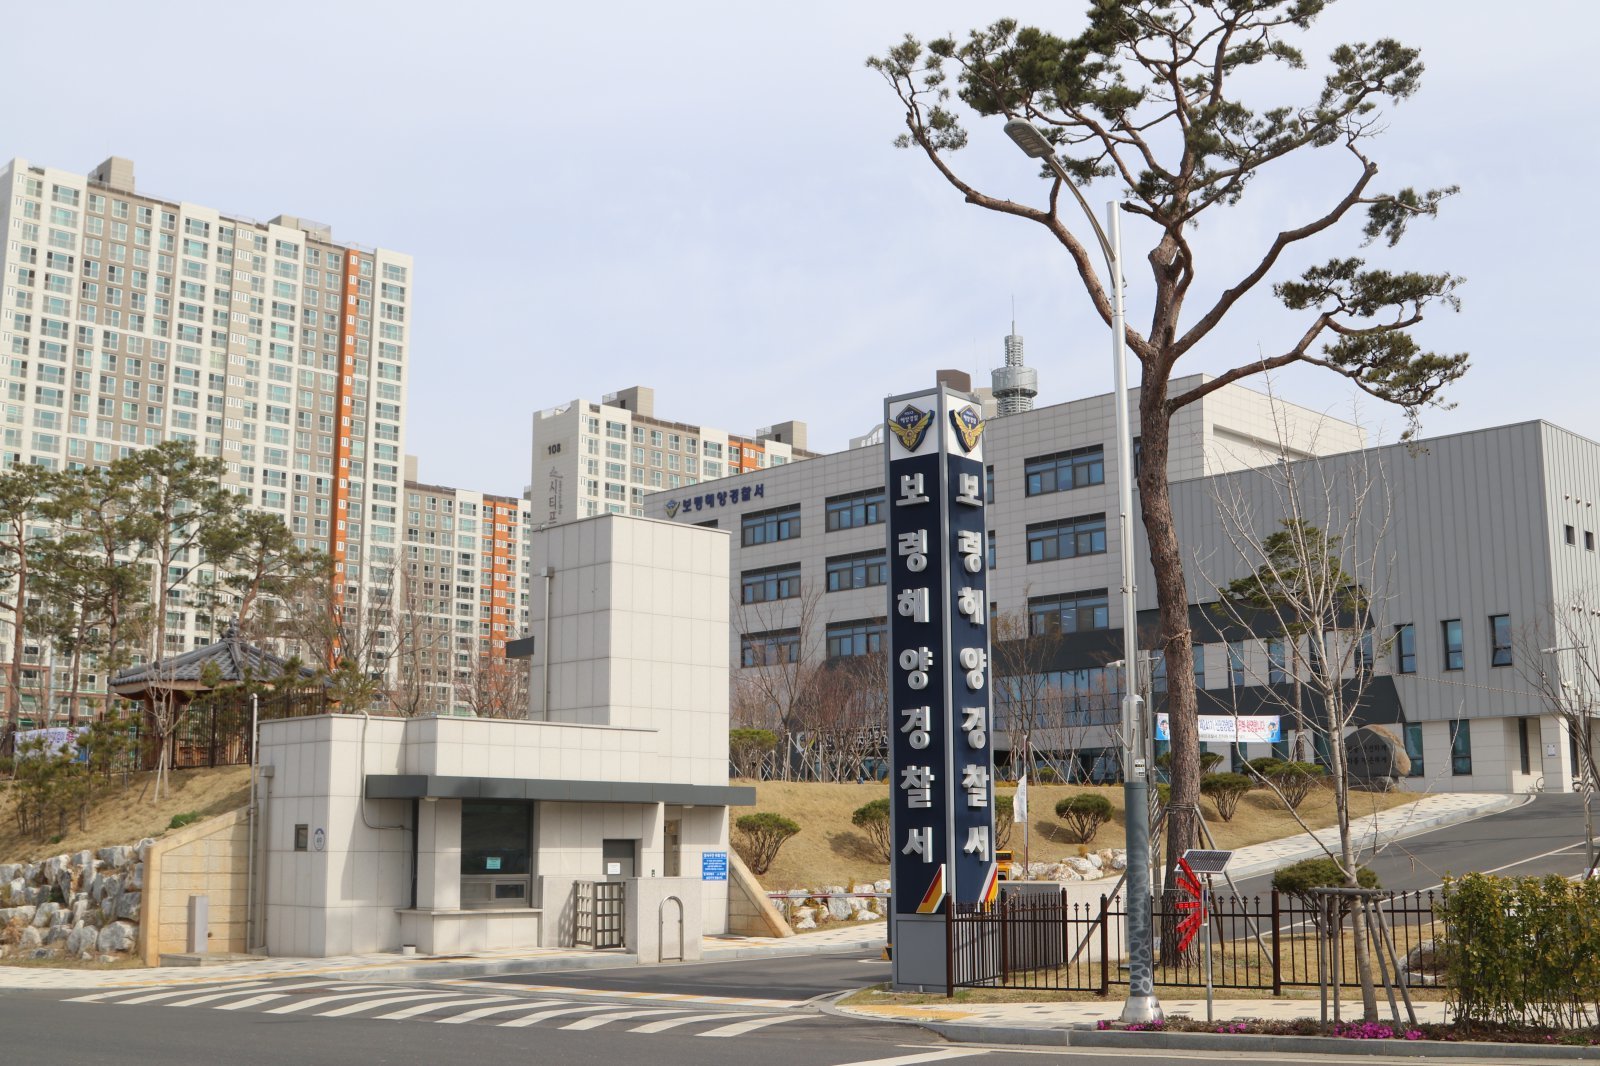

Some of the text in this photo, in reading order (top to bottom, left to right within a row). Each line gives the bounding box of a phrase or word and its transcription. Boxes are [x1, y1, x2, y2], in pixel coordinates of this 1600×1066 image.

[682, 483, 764, 513] 보령해양경찰서
[895, 472, 935, 863] 보령해양경찰서
[956, 472, 990, 862] 보령해양경찰서
